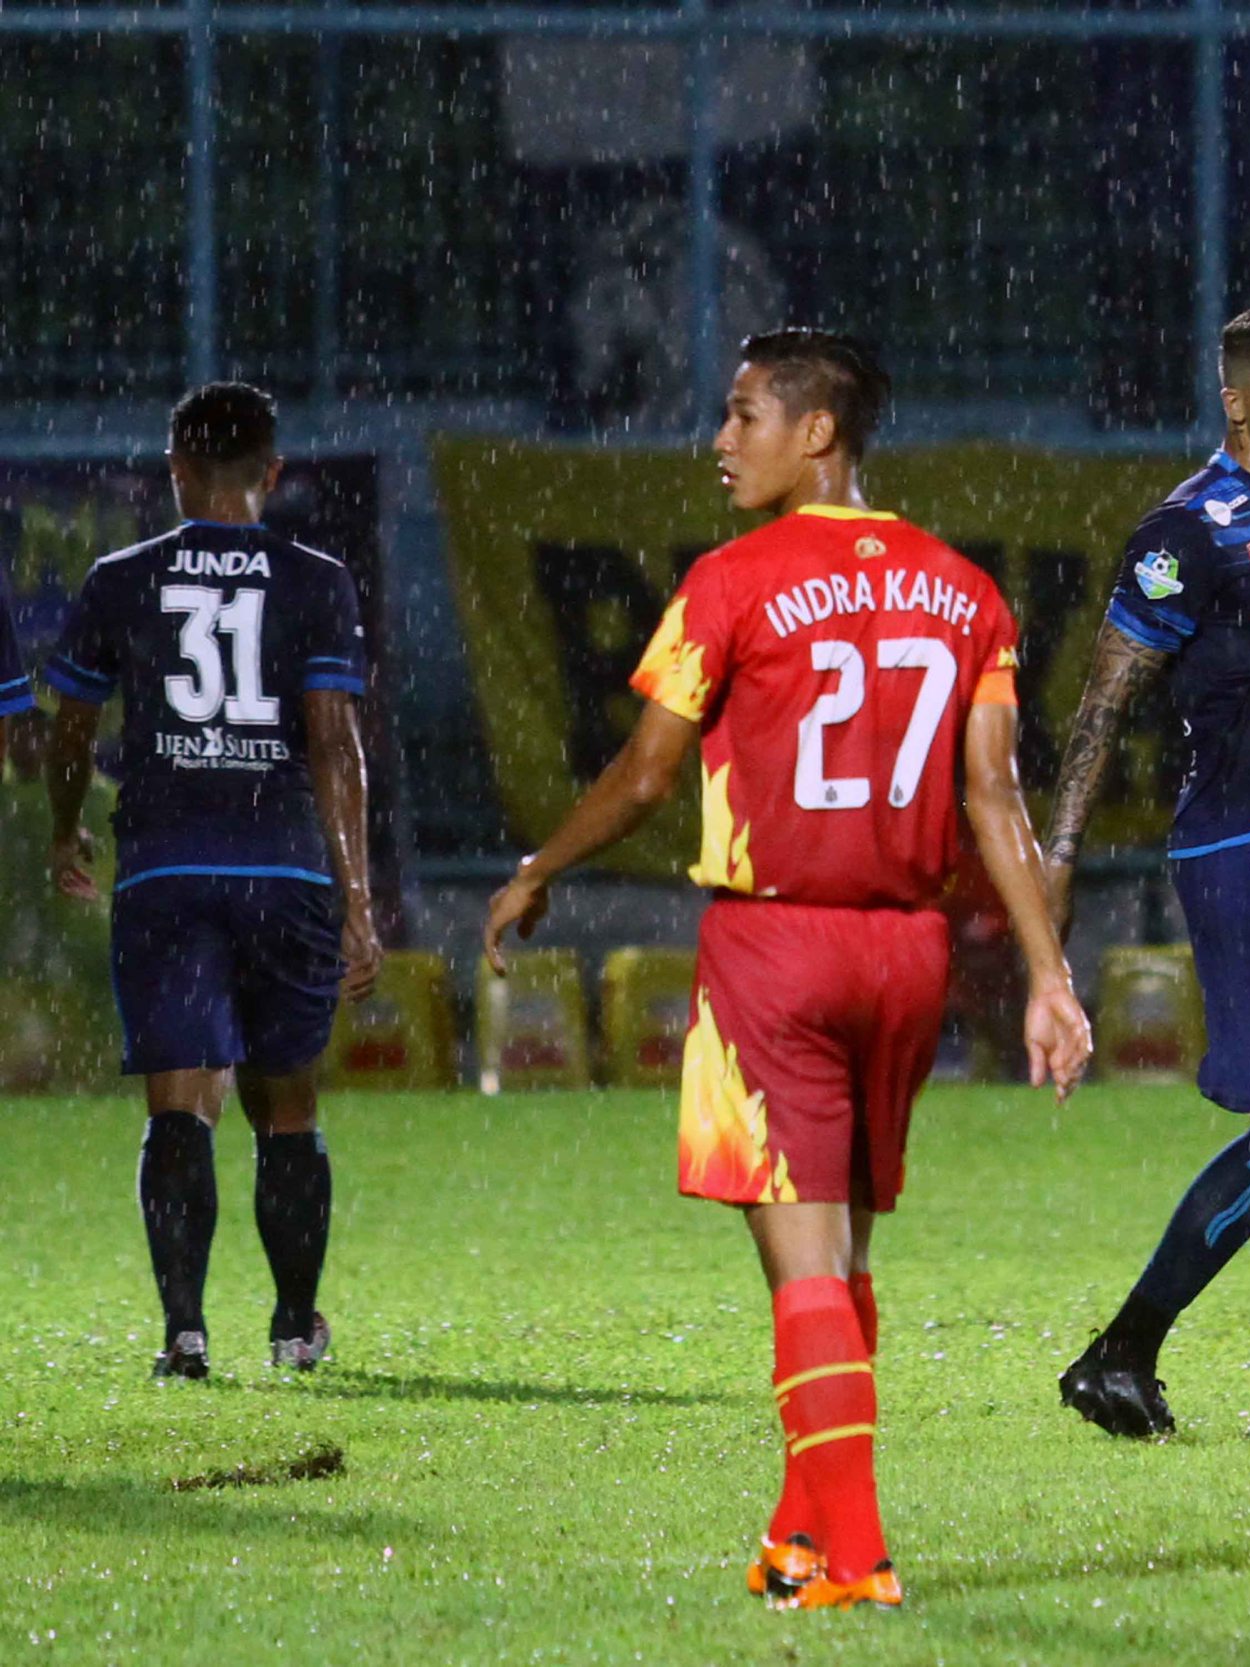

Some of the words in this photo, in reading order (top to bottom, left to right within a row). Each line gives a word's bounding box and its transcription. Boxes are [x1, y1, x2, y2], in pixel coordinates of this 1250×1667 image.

[166, 550, 272, 578] JUNDA
[764, 571, 876, 638] INDRA
[160, 584, 280, 725] 31
[155, 732, 201, 759] IJEN
[794, 636, 958, 811] 27
